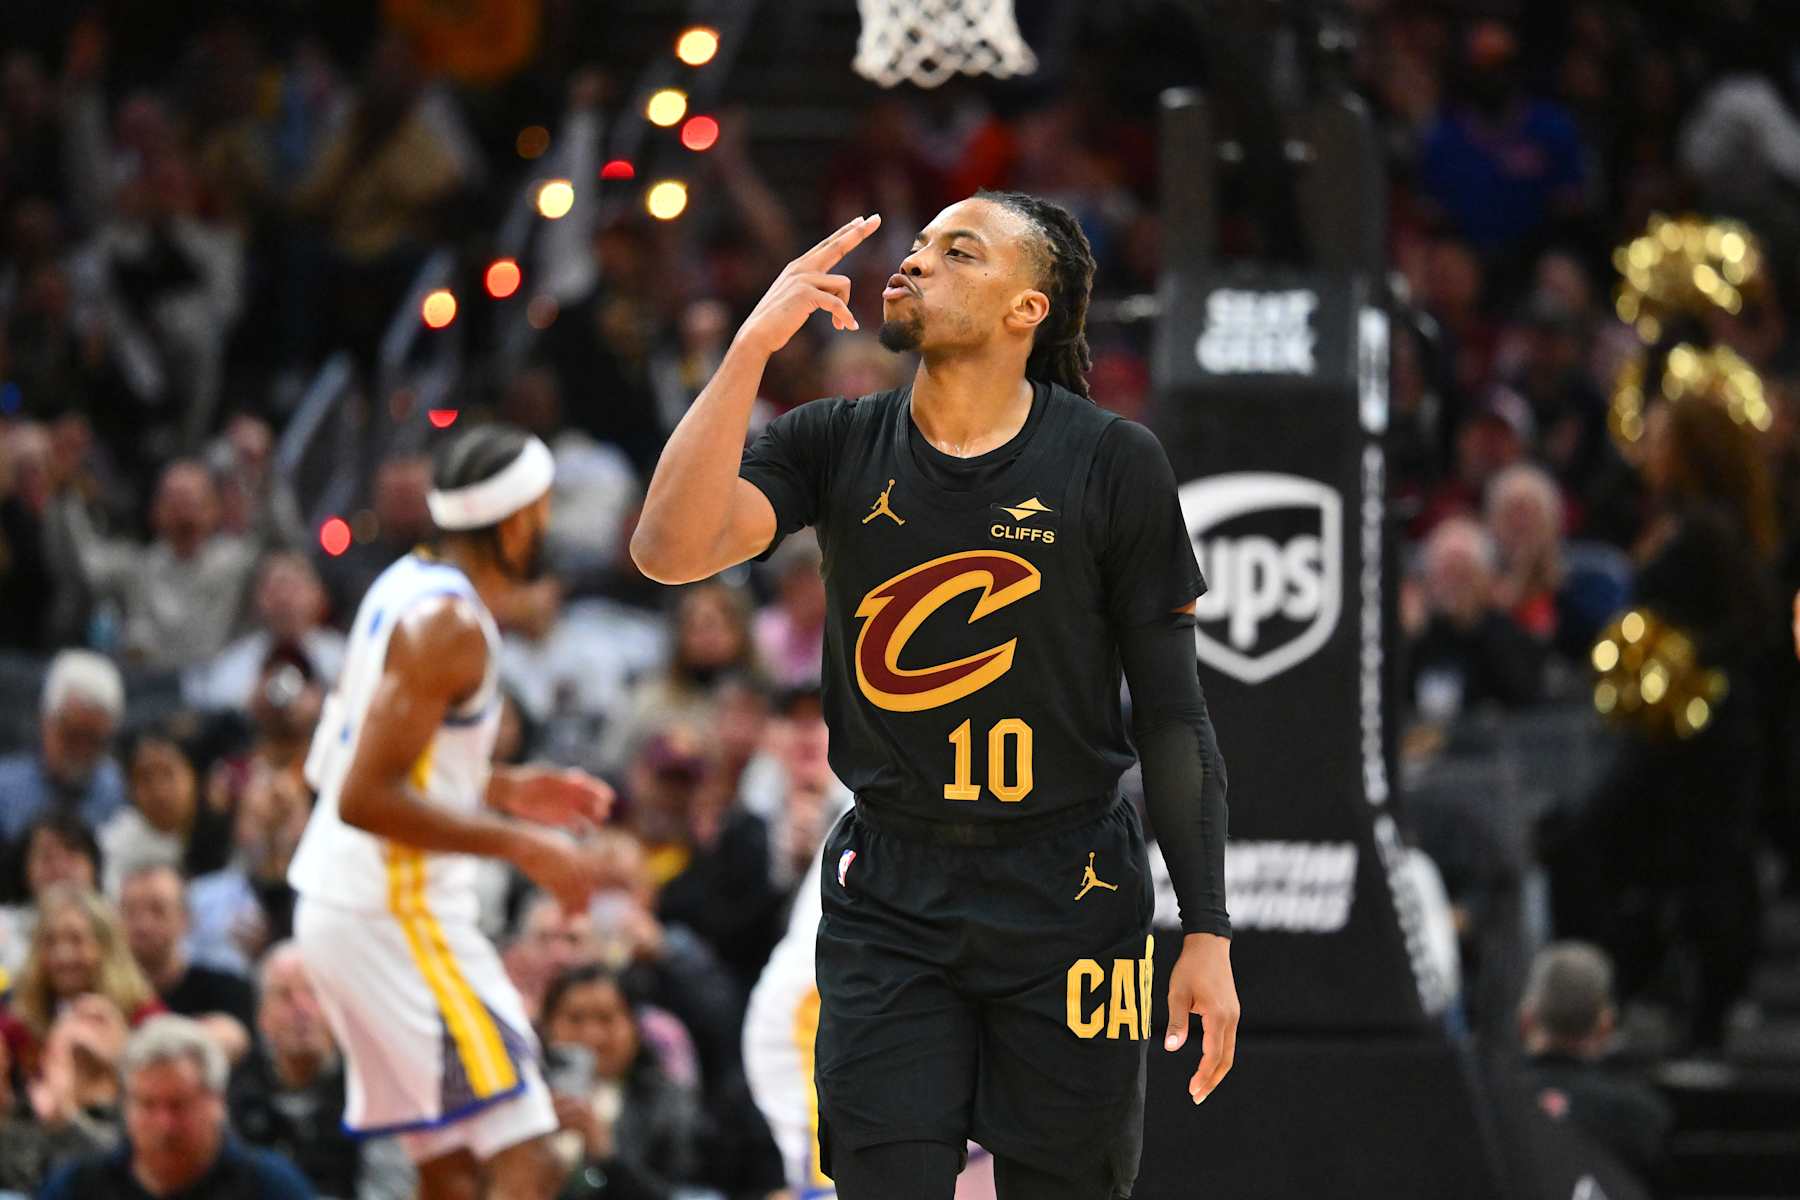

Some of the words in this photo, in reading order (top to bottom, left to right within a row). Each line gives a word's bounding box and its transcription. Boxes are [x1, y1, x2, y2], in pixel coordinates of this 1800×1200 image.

[990, 524, 1056, 544] CLIFFS
[854, 549, 1042, 712] C
[943, 718, 1034, 802] 10
